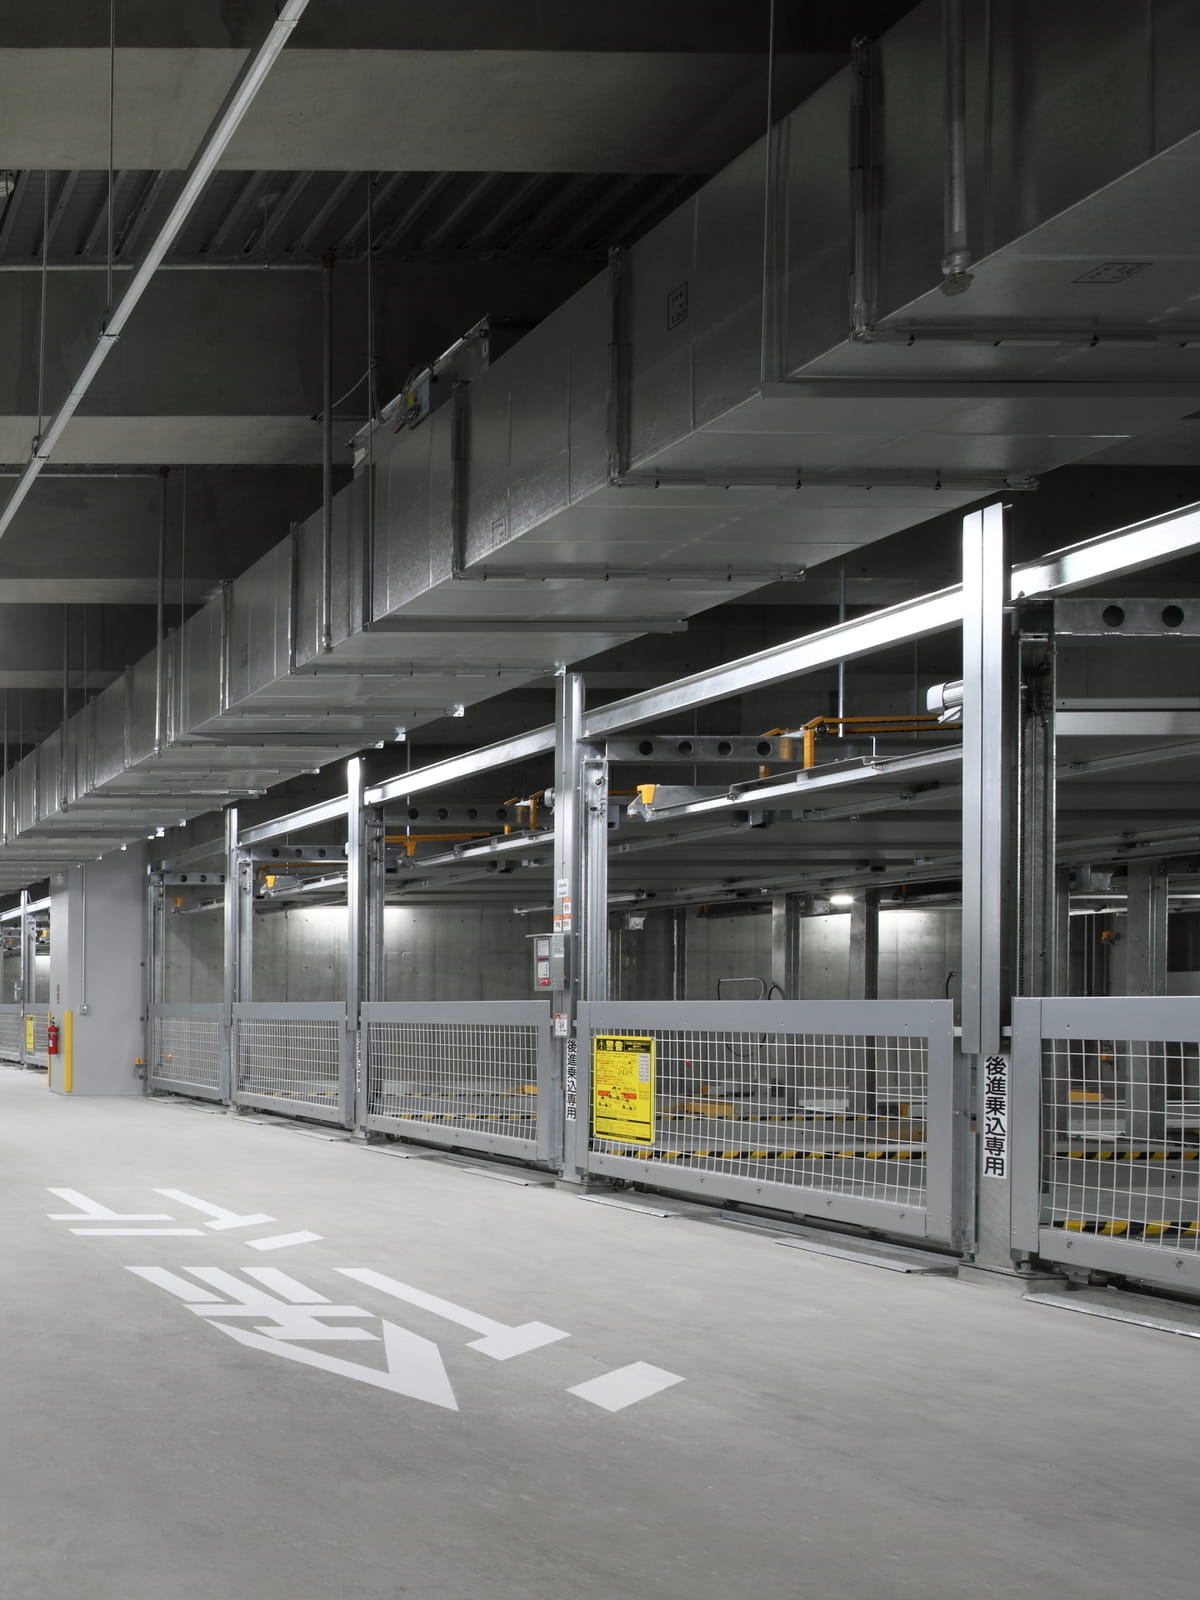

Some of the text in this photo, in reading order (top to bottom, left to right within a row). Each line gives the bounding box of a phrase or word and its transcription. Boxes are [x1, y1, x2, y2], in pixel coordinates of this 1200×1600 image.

[567, 1039, 577, 1120] 後進乗込専用
[984, 1056, 1007, 1177] 後進乗込専用
